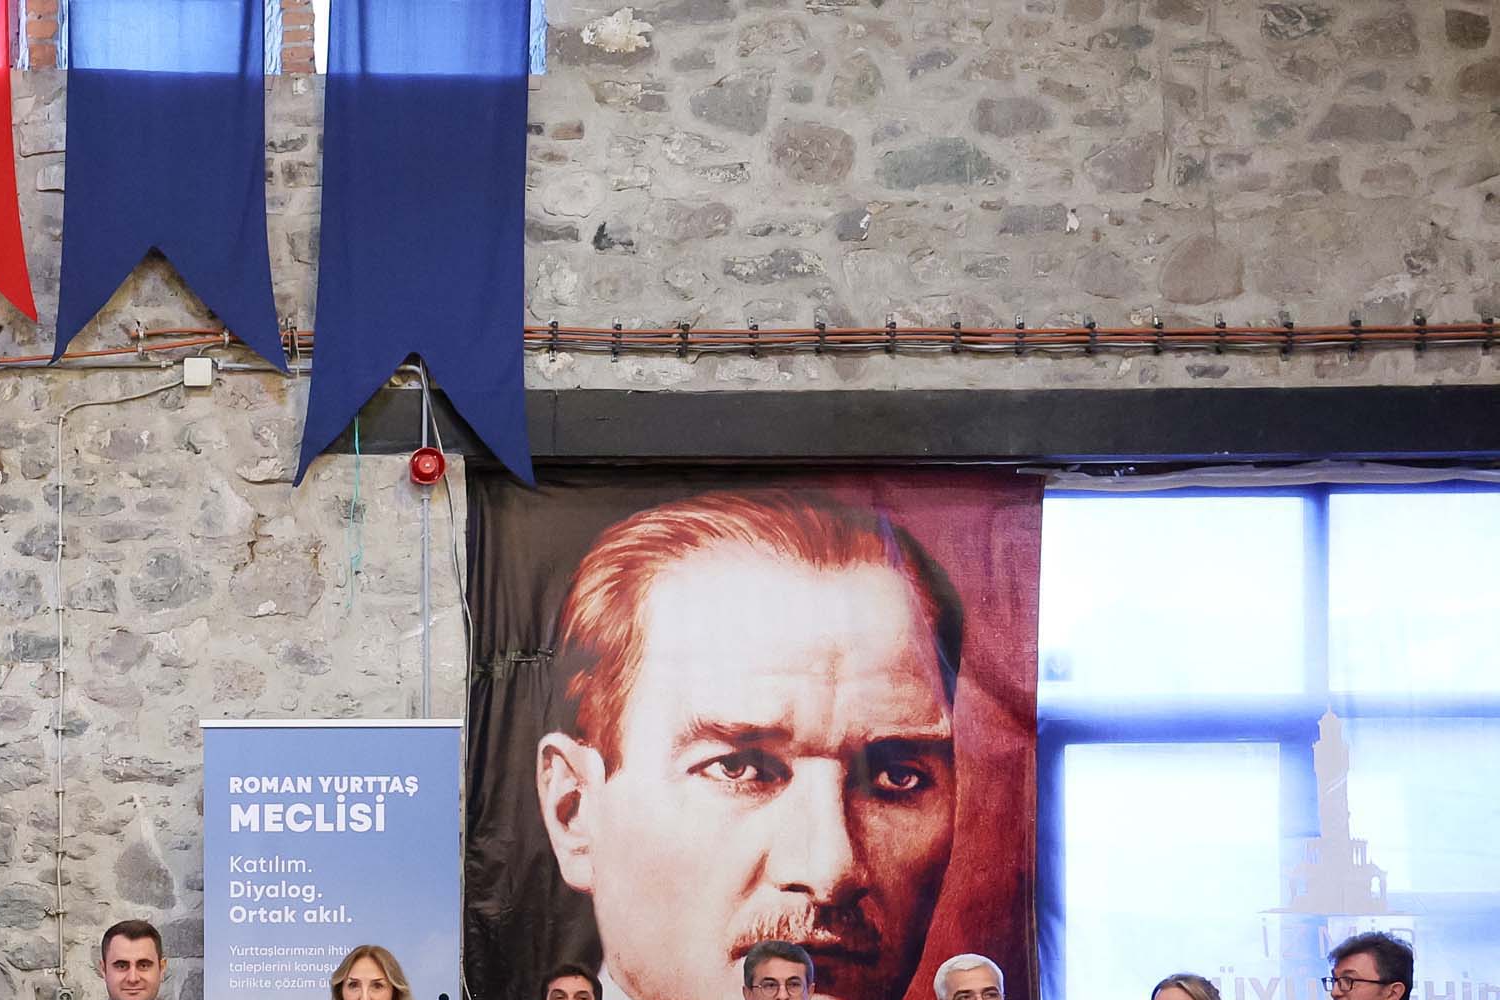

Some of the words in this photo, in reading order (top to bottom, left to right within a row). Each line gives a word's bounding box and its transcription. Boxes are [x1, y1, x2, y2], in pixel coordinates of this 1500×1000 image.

[229, 776, 312, 794] ROMAN
[317, 775, 419, 796] YURTTAŞ
[230, 794, 386, 832] MECLİSİ
[230, 855, 313, 873] Katılım.
[229, 880, 323, 902] Diyalog.
[229, 905, 297, 923] Ortak
[303, 905, 353, 923] akıl.
[229, 944, 325, 957] Yurttaşlarımızın
[229, 961, 291, 973] taleplerini
[229, 977, 272, 988] birlikte
[274, 978, 316, 990] çözüm
